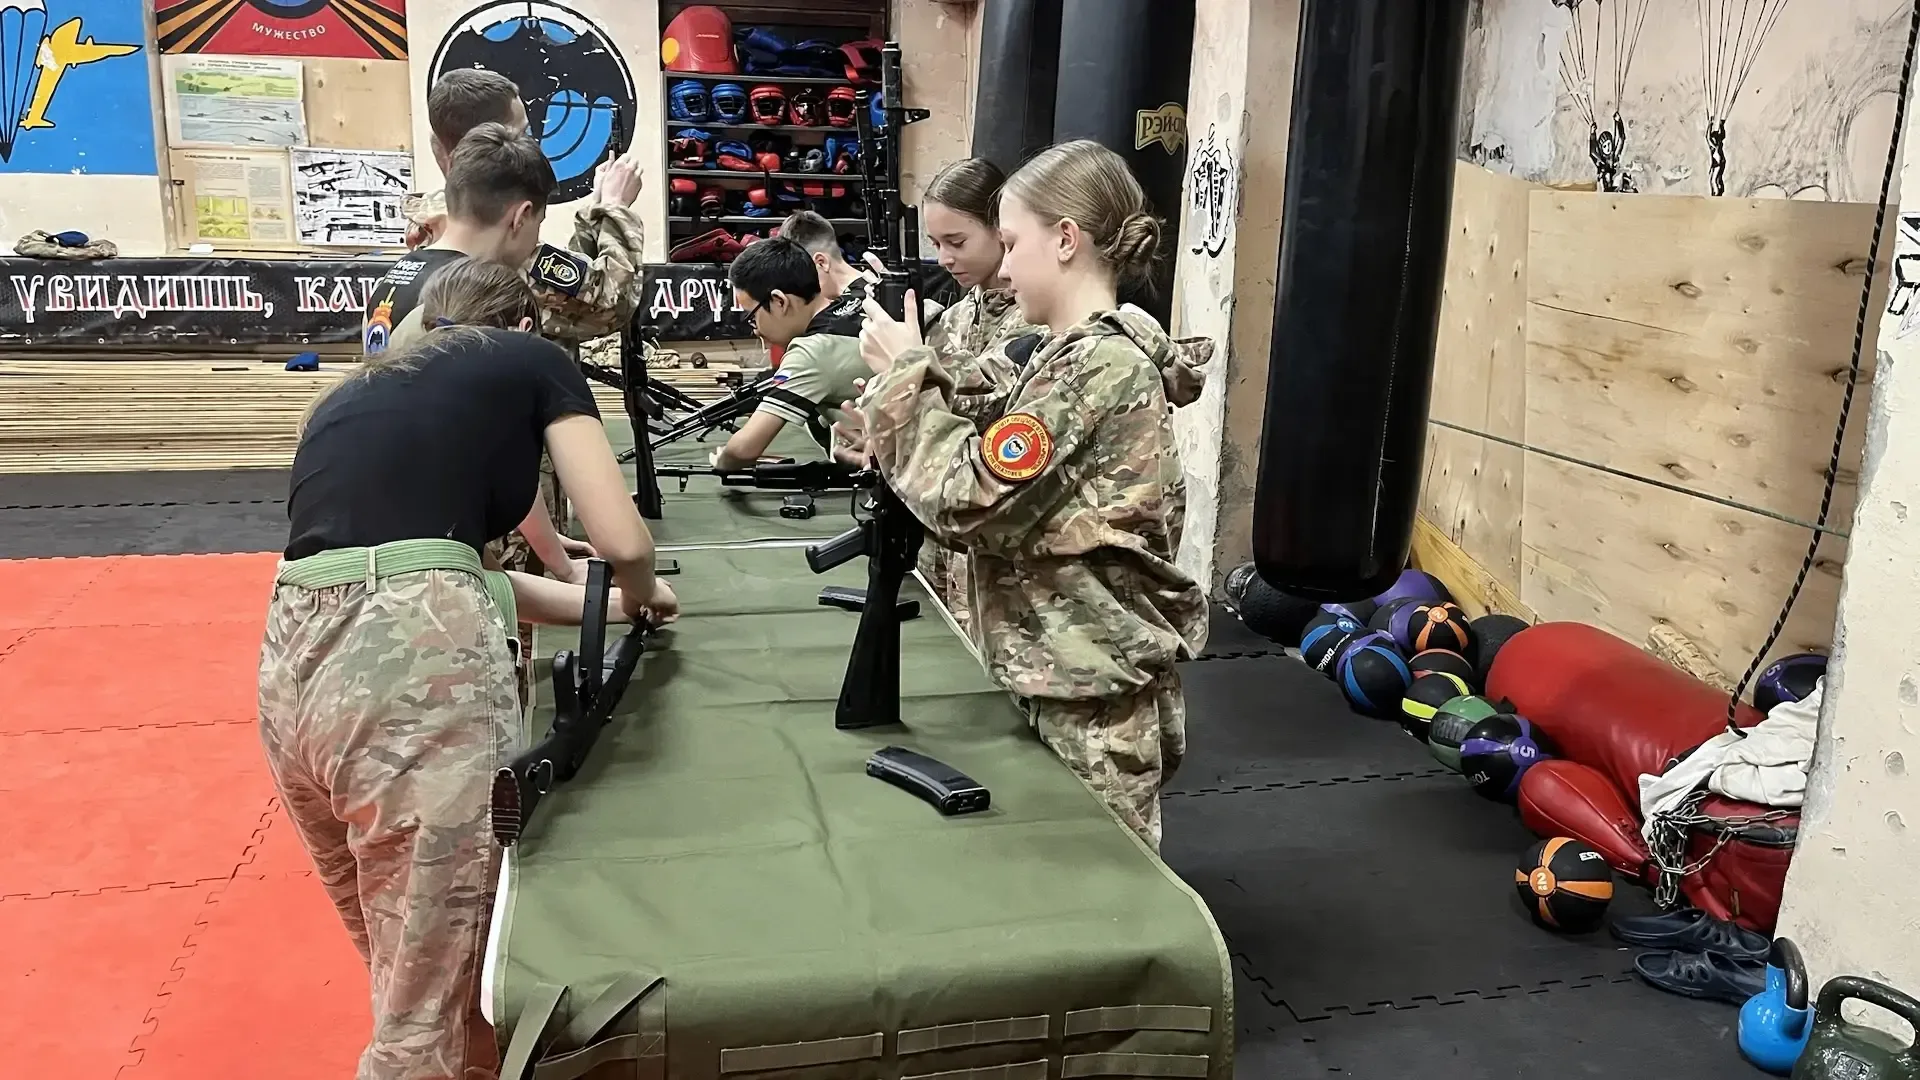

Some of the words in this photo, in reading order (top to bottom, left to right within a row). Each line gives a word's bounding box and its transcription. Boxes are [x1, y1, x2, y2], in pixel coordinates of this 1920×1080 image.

[252, 22, 326, 40] МУЖЕСТВО
[10, 275, 274, 323] УВИДИШЬ,
[1766, 664, 1780, 676] 5
[1520, 745, 1535, 758] 5
[1537, 872, 1547, 885] 2
